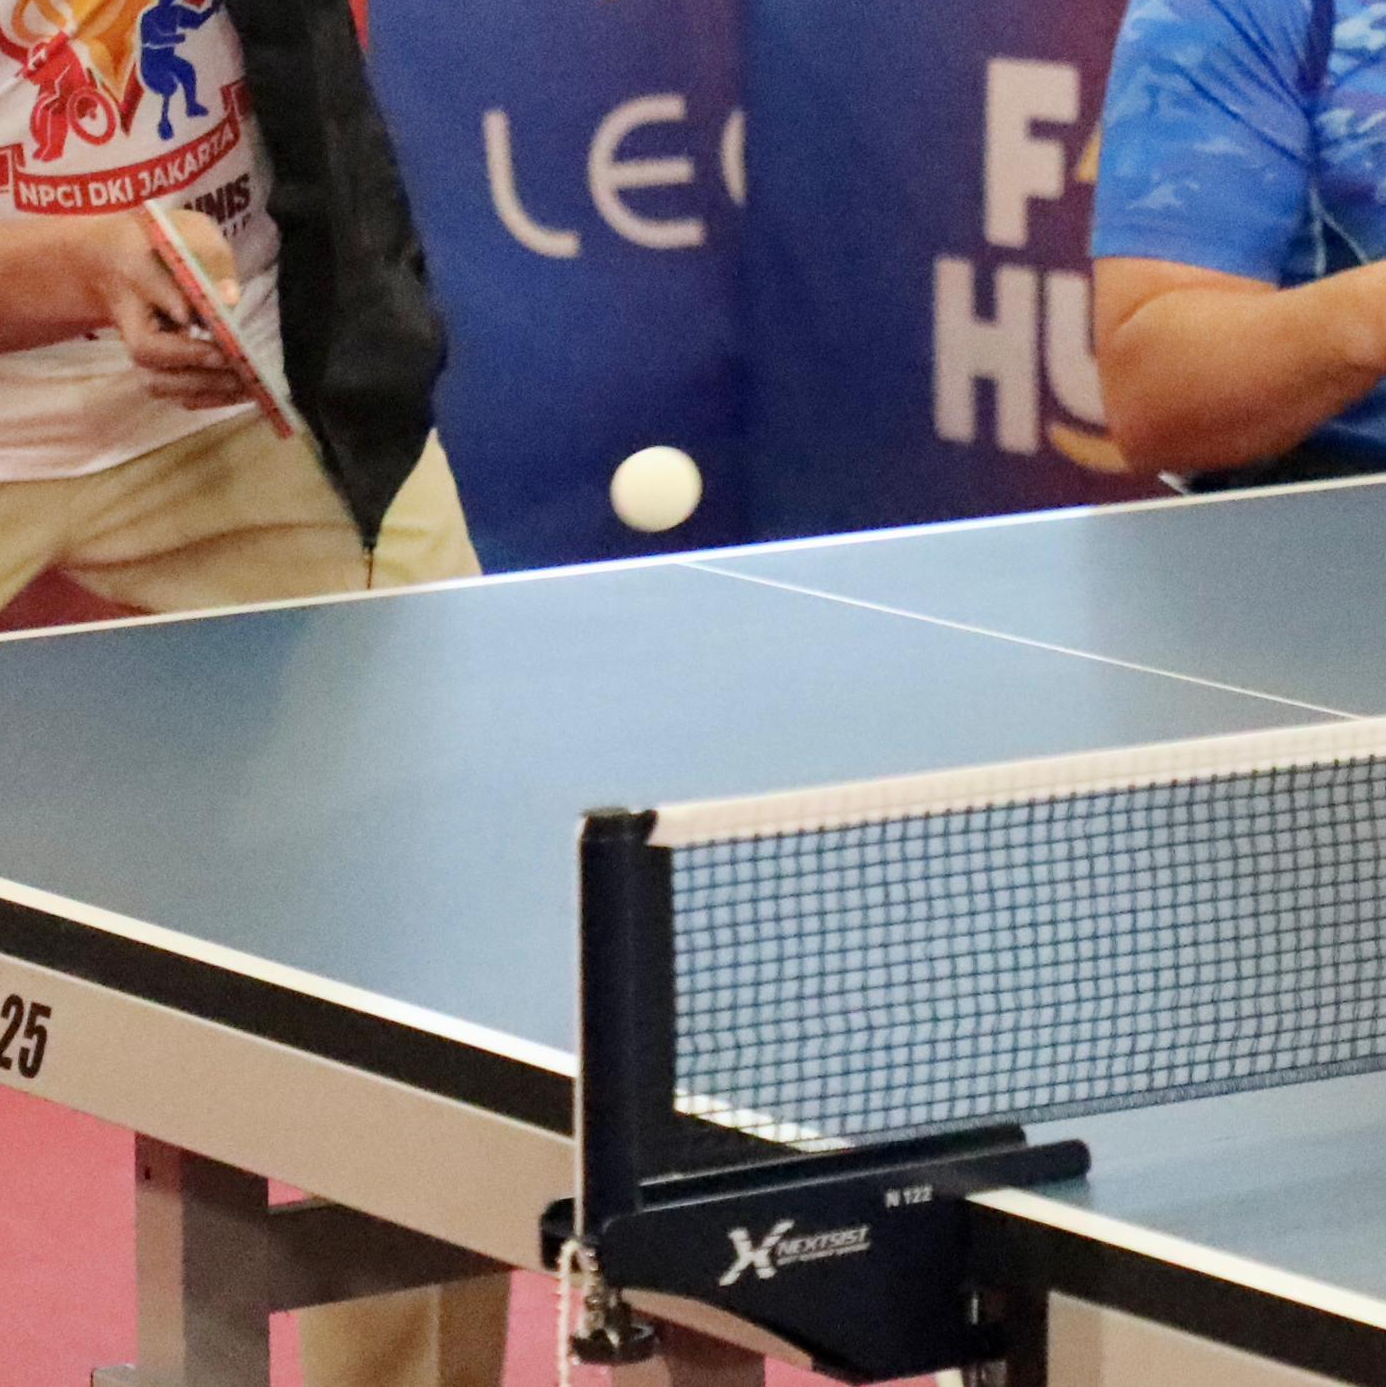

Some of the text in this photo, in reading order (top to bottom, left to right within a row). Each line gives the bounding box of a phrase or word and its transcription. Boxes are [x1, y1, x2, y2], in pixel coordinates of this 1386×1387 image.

[18, 122, 236, 209] NPCI DKI JAKARTA
